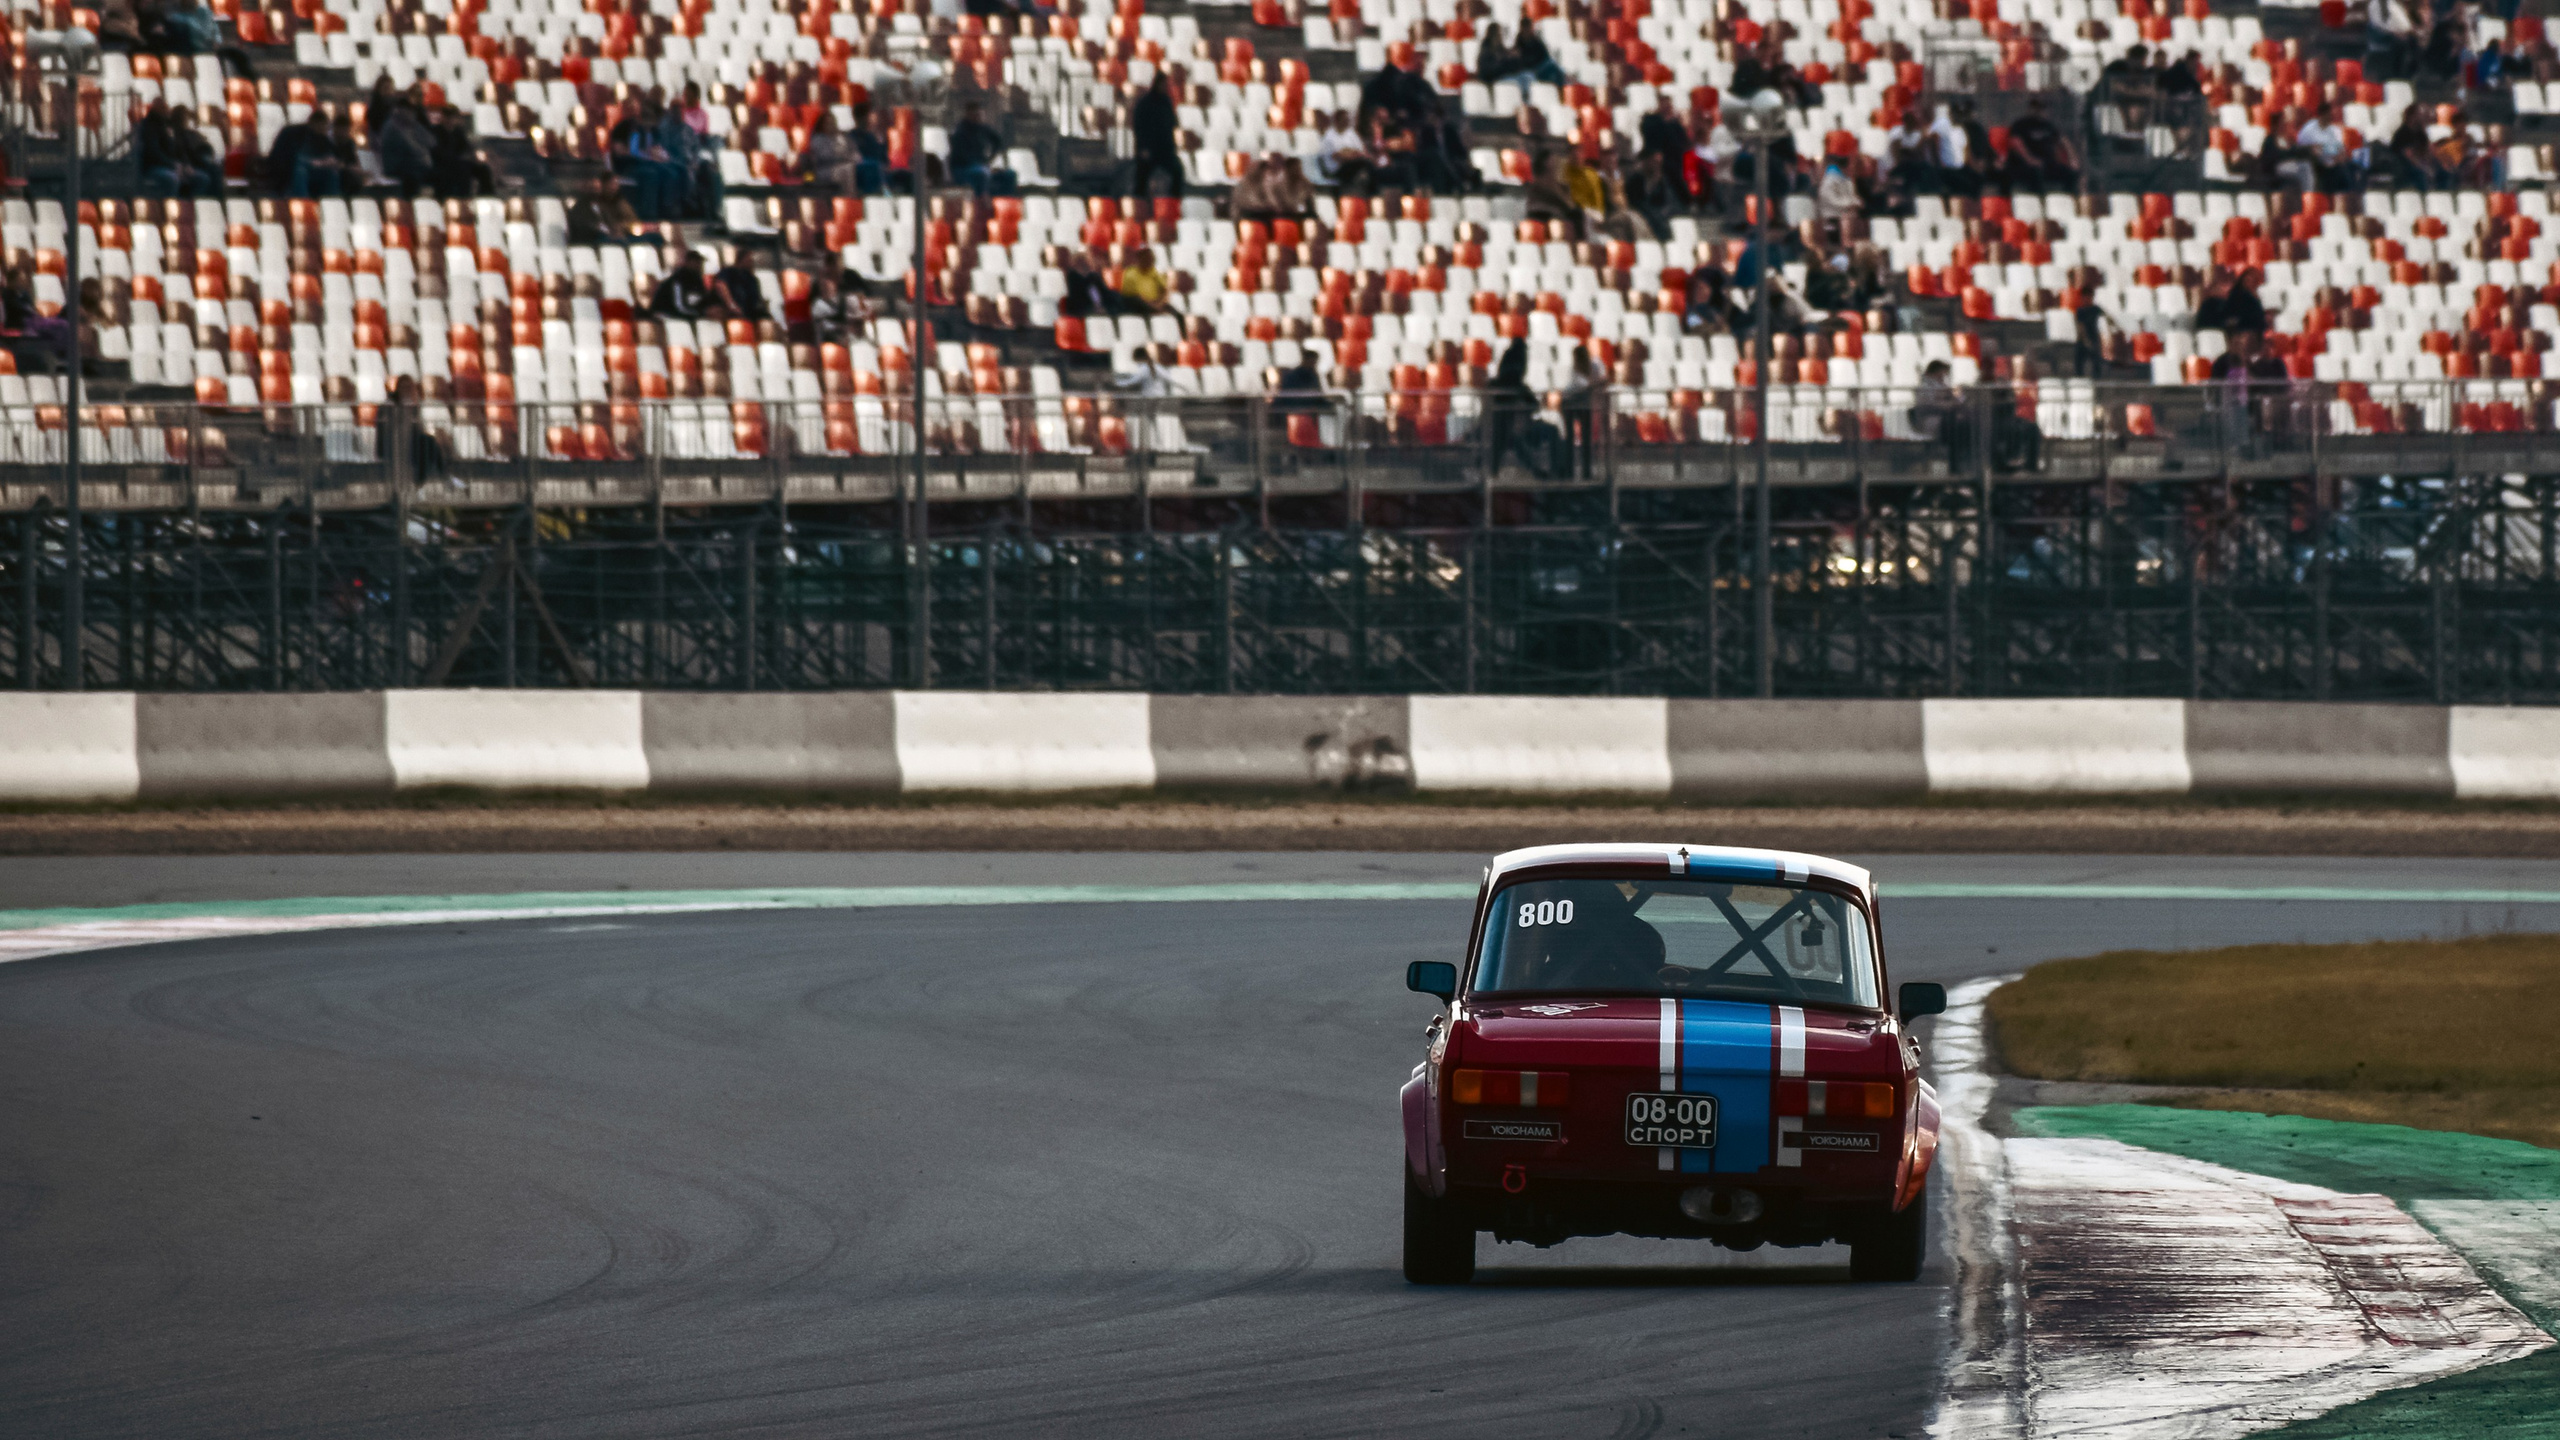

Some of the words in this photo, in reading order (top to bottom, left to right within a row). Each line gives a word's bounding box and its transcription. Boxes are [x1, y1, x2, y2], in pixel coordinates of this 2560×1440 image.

[1518, 900, 1574, 928] 800
[1632, 1097, 1712, 1126] 08-00
[1491, 1125, 1553, 1137] YOKOHAMA
[1630, 1127, 1712, 1145] СПОРТ
[1809, 1136, 1871, 1148] YOKOHAMA
